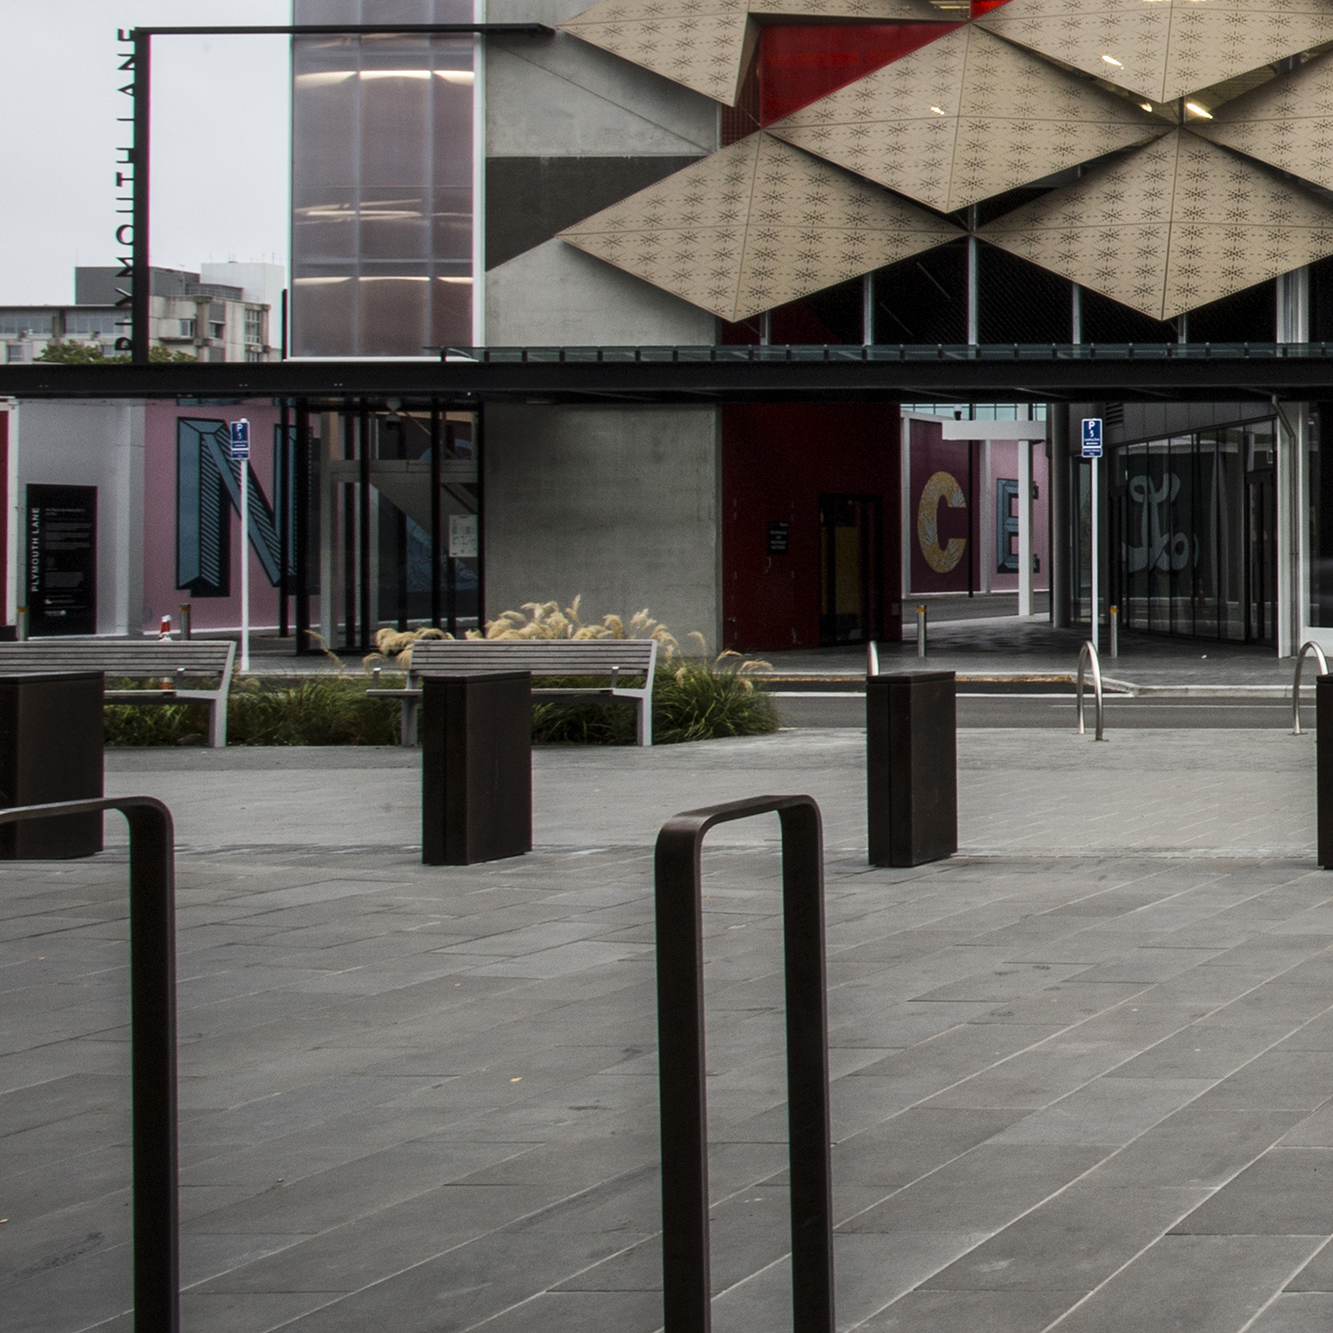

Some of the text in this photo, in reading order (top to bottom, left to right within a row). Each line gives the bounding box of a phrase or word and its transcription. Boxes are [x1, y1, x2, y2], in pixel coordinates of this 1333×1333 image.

[1089, 421, 1096, 430] P
[31, 507, 40, 592] PLYMOUTH LANE
